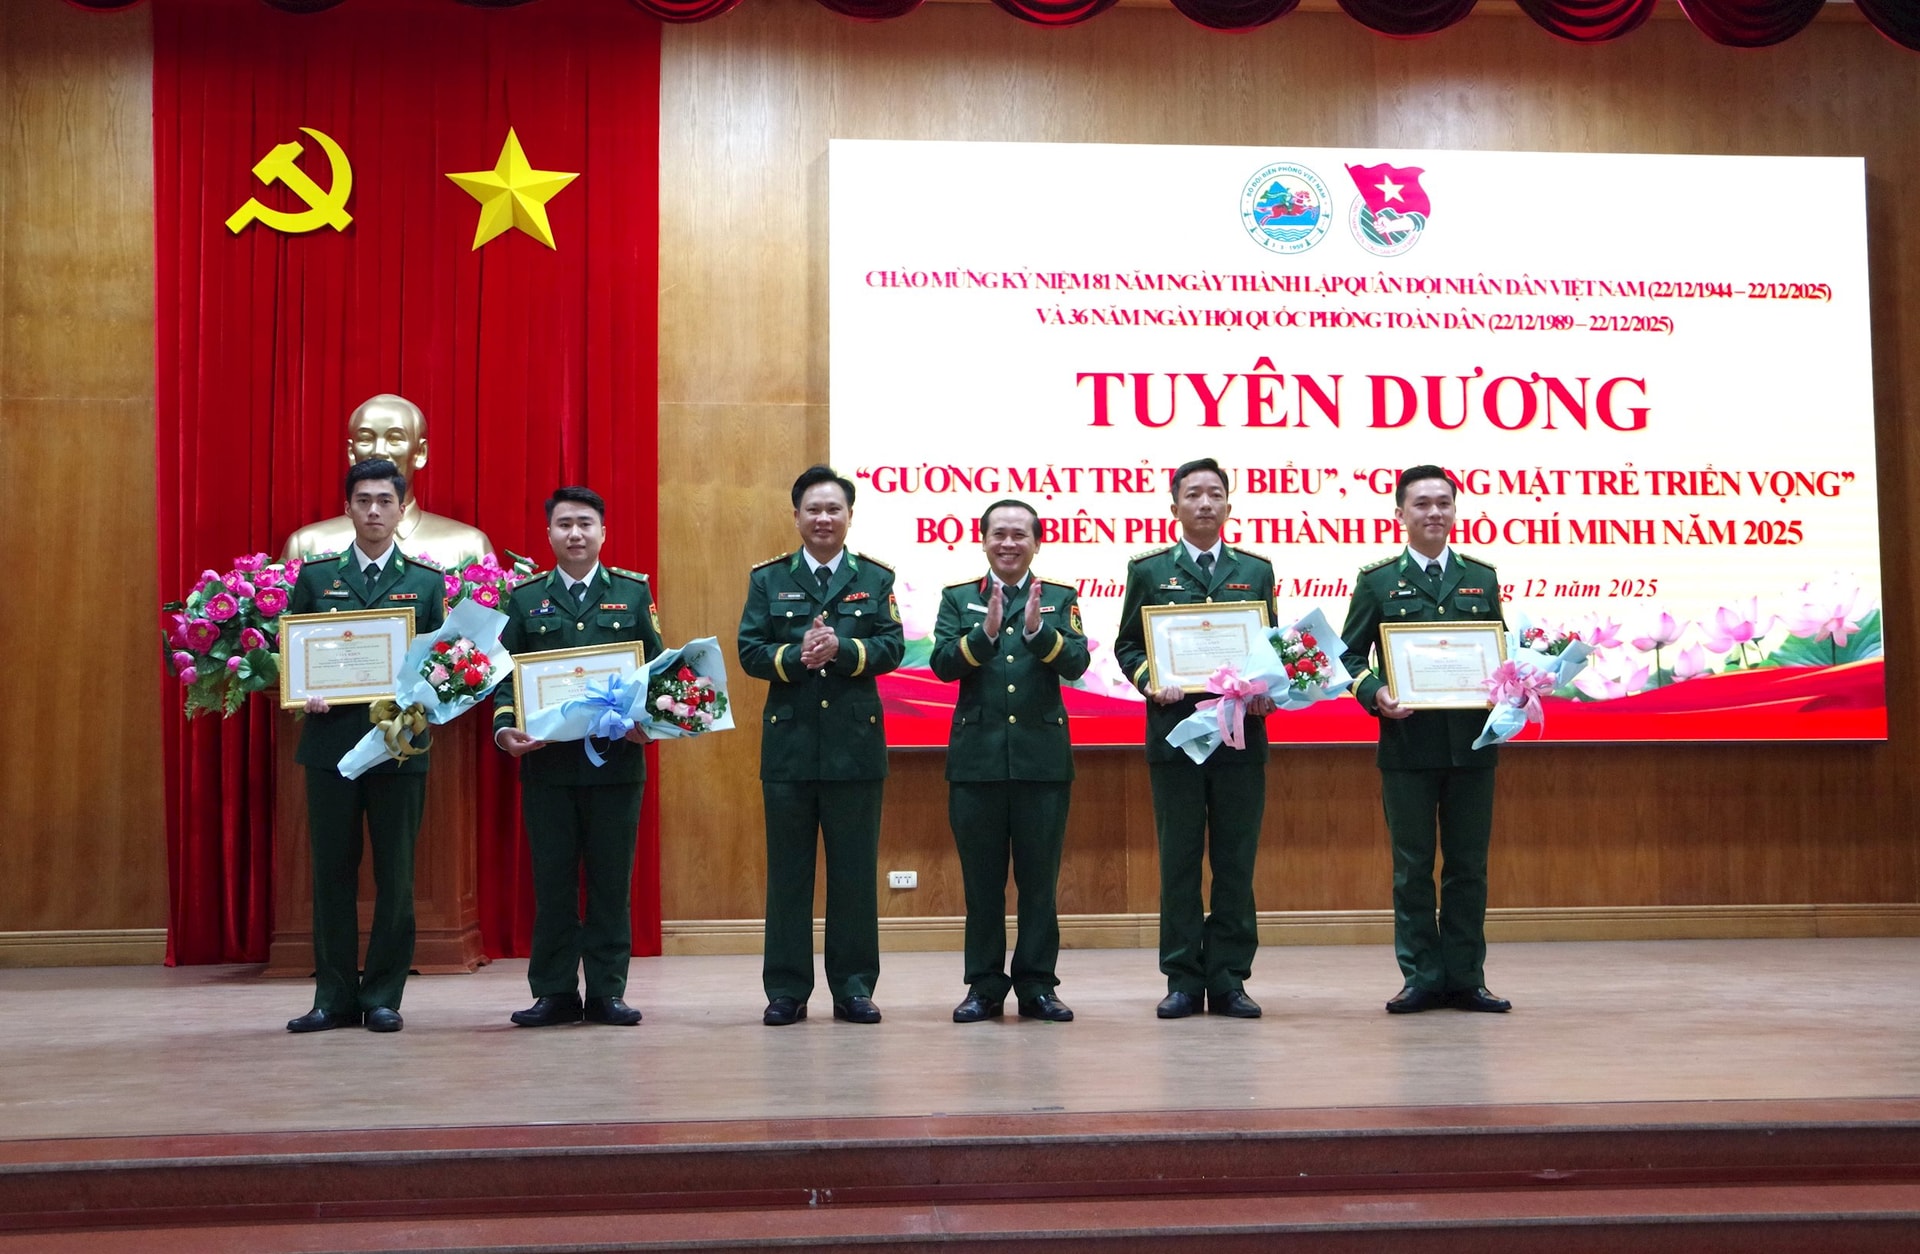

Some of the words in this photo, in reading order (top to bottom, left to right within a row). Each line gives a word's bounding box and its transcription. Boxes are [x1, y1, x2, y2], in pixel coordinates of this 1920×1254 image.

[865, 266, 929, 288] CHÀO
[931, 266, 998, 289] MỪNG
[1036, 271, 1089, 294] NIỆM
[1092, 273, 1111, 290] 81
[1115, 269, 1163, 290] NĂM
[1167, 270, 1226, 291] NGÀY
[1227, 270, 1300, 292] THÀNH
[1304, 274, 1344, 298] LẬP
[1344, 271, 1403, 296] QUÂN
[1406, 275, 1441, 299] ĐỘI
[1445, 272, 1502, 295] NHÂN
[1506, 273, 1547, 296] DÂN
[1549, 278, 1597, 301] VIỆT
[1599, 280, 1645, 297] NAM
[1648, 281, 1733, 301] (22/12/1944
[1748, 282, 1832, 303] 22/12/2025)
[1036, 304, 1066, 325] VÀ
[1068, 308, 1089, 325] 36
[1091, 304, 1140, 326] NĂM
[1143, 305, 1203, 326] NGÀY
[1205, 307, 1243, 332] HỘI
[1246, 305, 1307, 330] QUỐC
[1309, 307, 1382, 328] PHÒNG
[1384, 308, 1440, 329] TOÀN
[1443, 307, 1485, 329] DÂN
[1488, 313, 1574, 333] (22/12/1989
[1589, 315, 1674, 336] 22/12/2025)
[1076, 356, 1345, 430] TUYÊN
[1365, 365, 1652, 432] DƯƠNG
[856, 463, 1000, 493] “GƯƠNG
[1007, 464, 1084, 500] MẶT
[1088, 459, 1155, 493] TRẺ
[1498, 466, 1571, 502] MẶT
[1575, 462, 1639, 495] TRẺ
[1644, 464, 1741, 496] TRIỂN
[1747, 470, 1855, 503] VỌNG”
[916, 514, 964, 551] BỘ
[1039, 509, 1116, 544] BIÊN
[1125, 517, 1242, 544] PHG
[1248, 511, 1365, 544] THÀNH
[1448, 511, 1497, 544] HỒ
[1503, 512, 1561, 545] CHÍ
[1568, 520, 1656, 544] MINH
[1662, 513, 1737, 545] NĂM
[1743, 520, 1803, 545] 2025
[1289, 578, 1354, 600] Minh,
[1524, 578, 1547, 597] 12
[1554, 580, 1600, 597] năm
[1608, 578, 1658, 597] 2025
